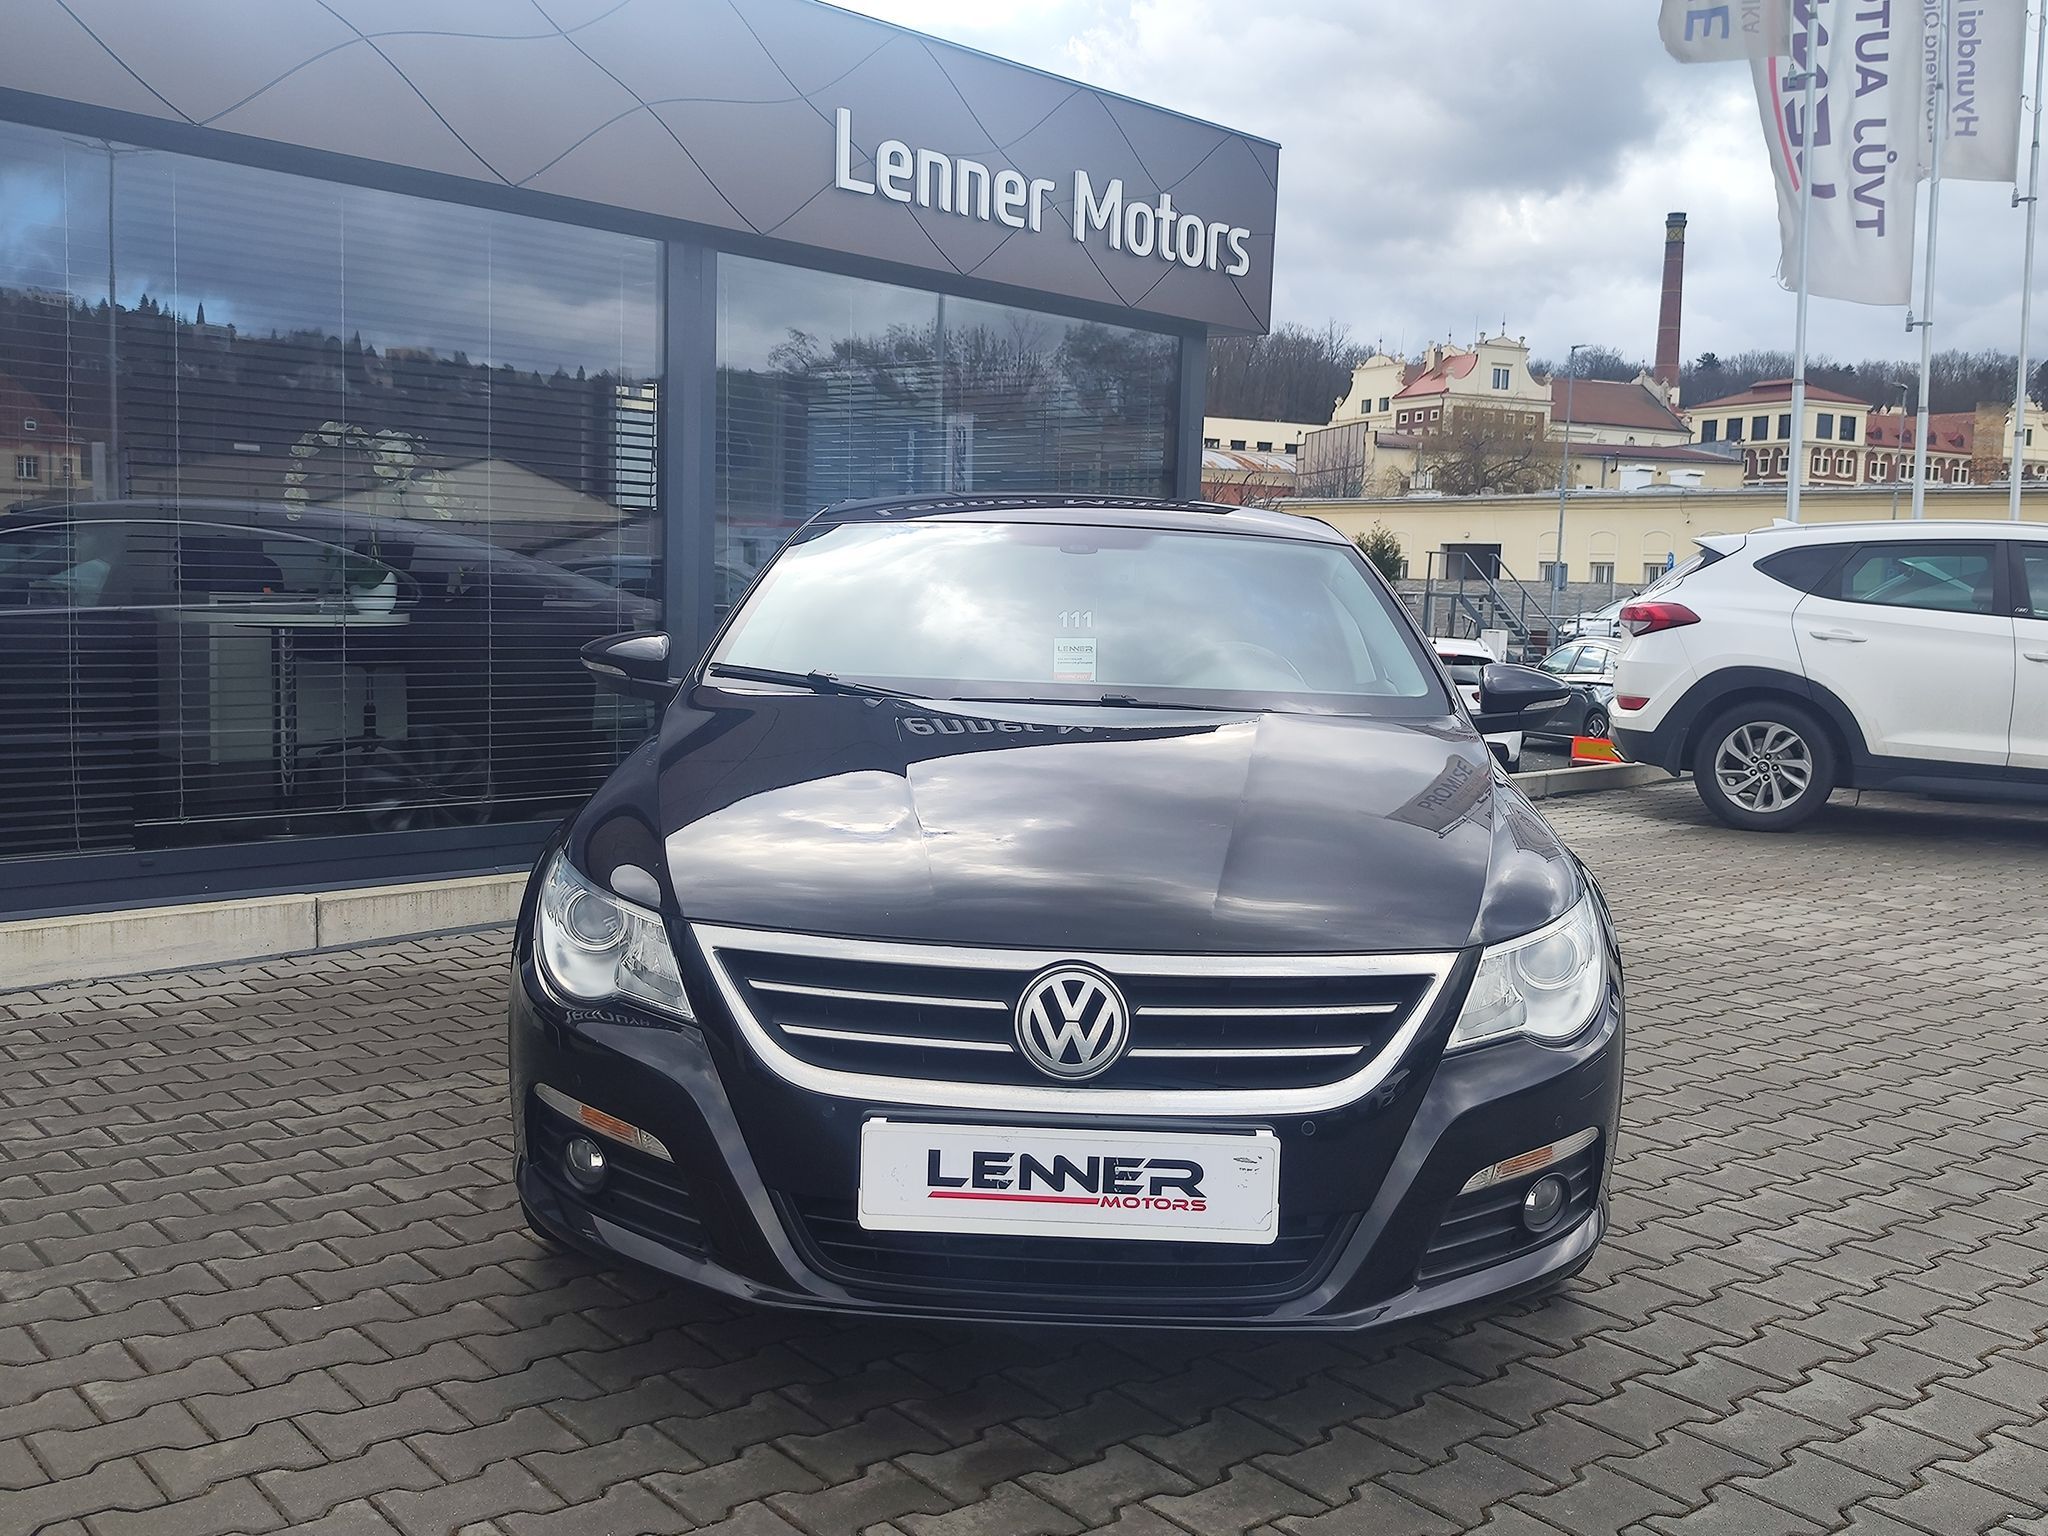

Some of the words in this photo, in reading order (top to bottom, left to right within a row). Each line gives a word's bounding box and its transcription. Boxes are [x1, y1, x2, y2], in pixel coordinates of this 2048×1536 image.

[835, 107, 1057, 234] Lenner
[1073, 169, 1251, 277] Motors
[1057, 609, 1094, 629] 111
[1417, 760, 1473, 811] PROMISE
[927, 1149, 1208, 1198] LENNER
[1099, 1197, 1208, 1212] MOTORS
